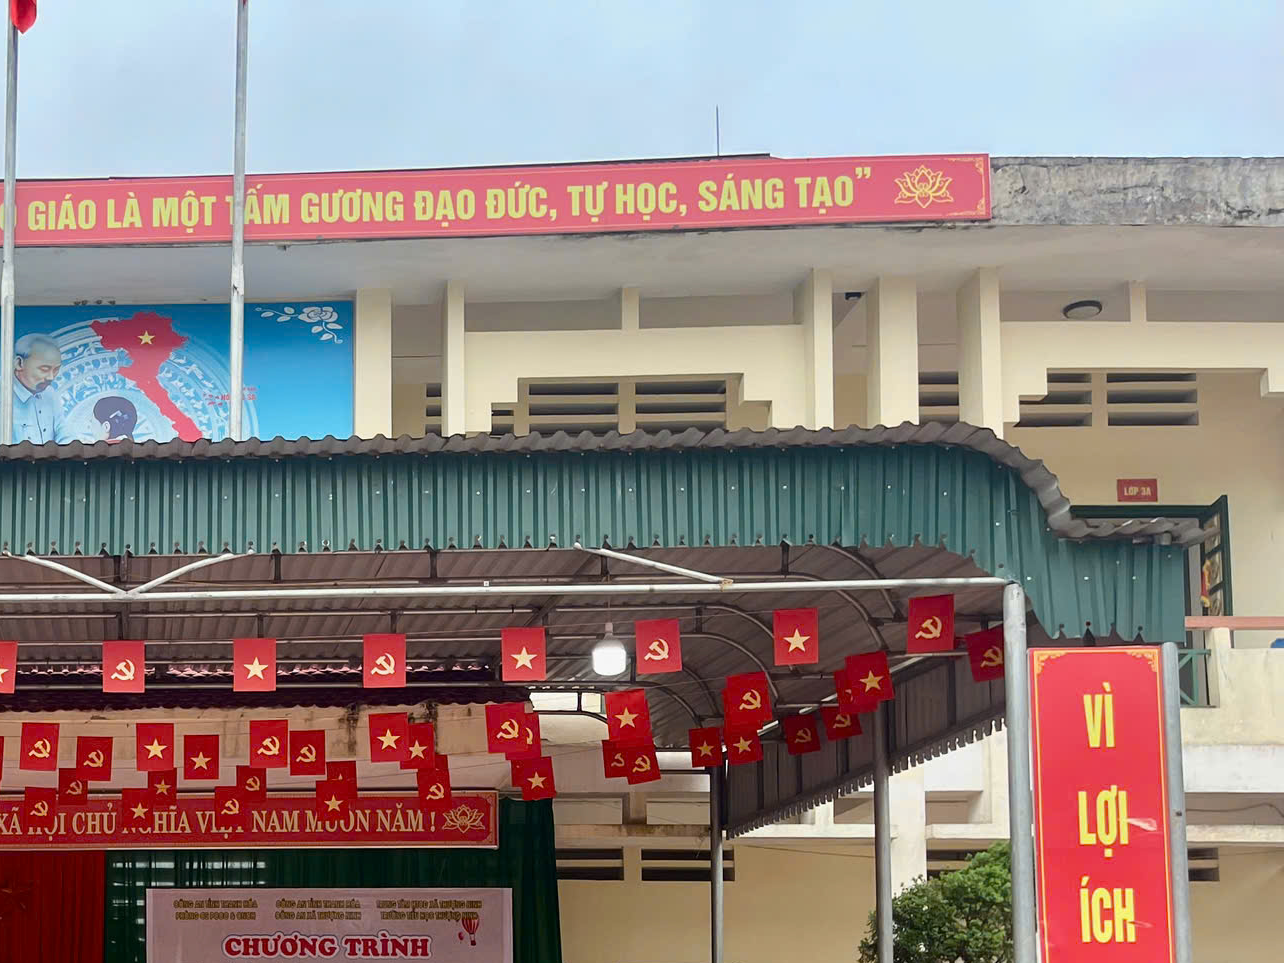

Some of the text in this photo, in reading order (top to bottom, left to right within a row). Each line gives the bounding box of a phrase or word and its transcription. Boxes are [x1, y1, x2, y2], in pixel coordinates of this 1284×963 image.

[27, 193, 97, 232] GIÁO
[107, 191, 143, 230] LÀ
[152, 189, 217, 233] MỘT
[300, 189, 405, 225] GƯƠNG
[413, 188, 476, 228] ĐẠO
[485, 181, 557, 222] ĐỨC,
[566, 181, 609, 223] TỰ
[615, 180, 688, 222] HỌC,
[698, 173, 785, 212] SÁNG
[1083, 681, 1115, 748] VÌ
[71, 801, 117, 835] CHỦ
[121, 806, 192, 834] HĨA
[251, 809, 300, 833] NAM
[375, 802, 425, 833] NĂM
[1078, 784, 1130, 858] LỢI
[1079, 875, 1137, 944] ÍCH
[224, 931, 430, 957] CHƯƠNG TRÌNH
